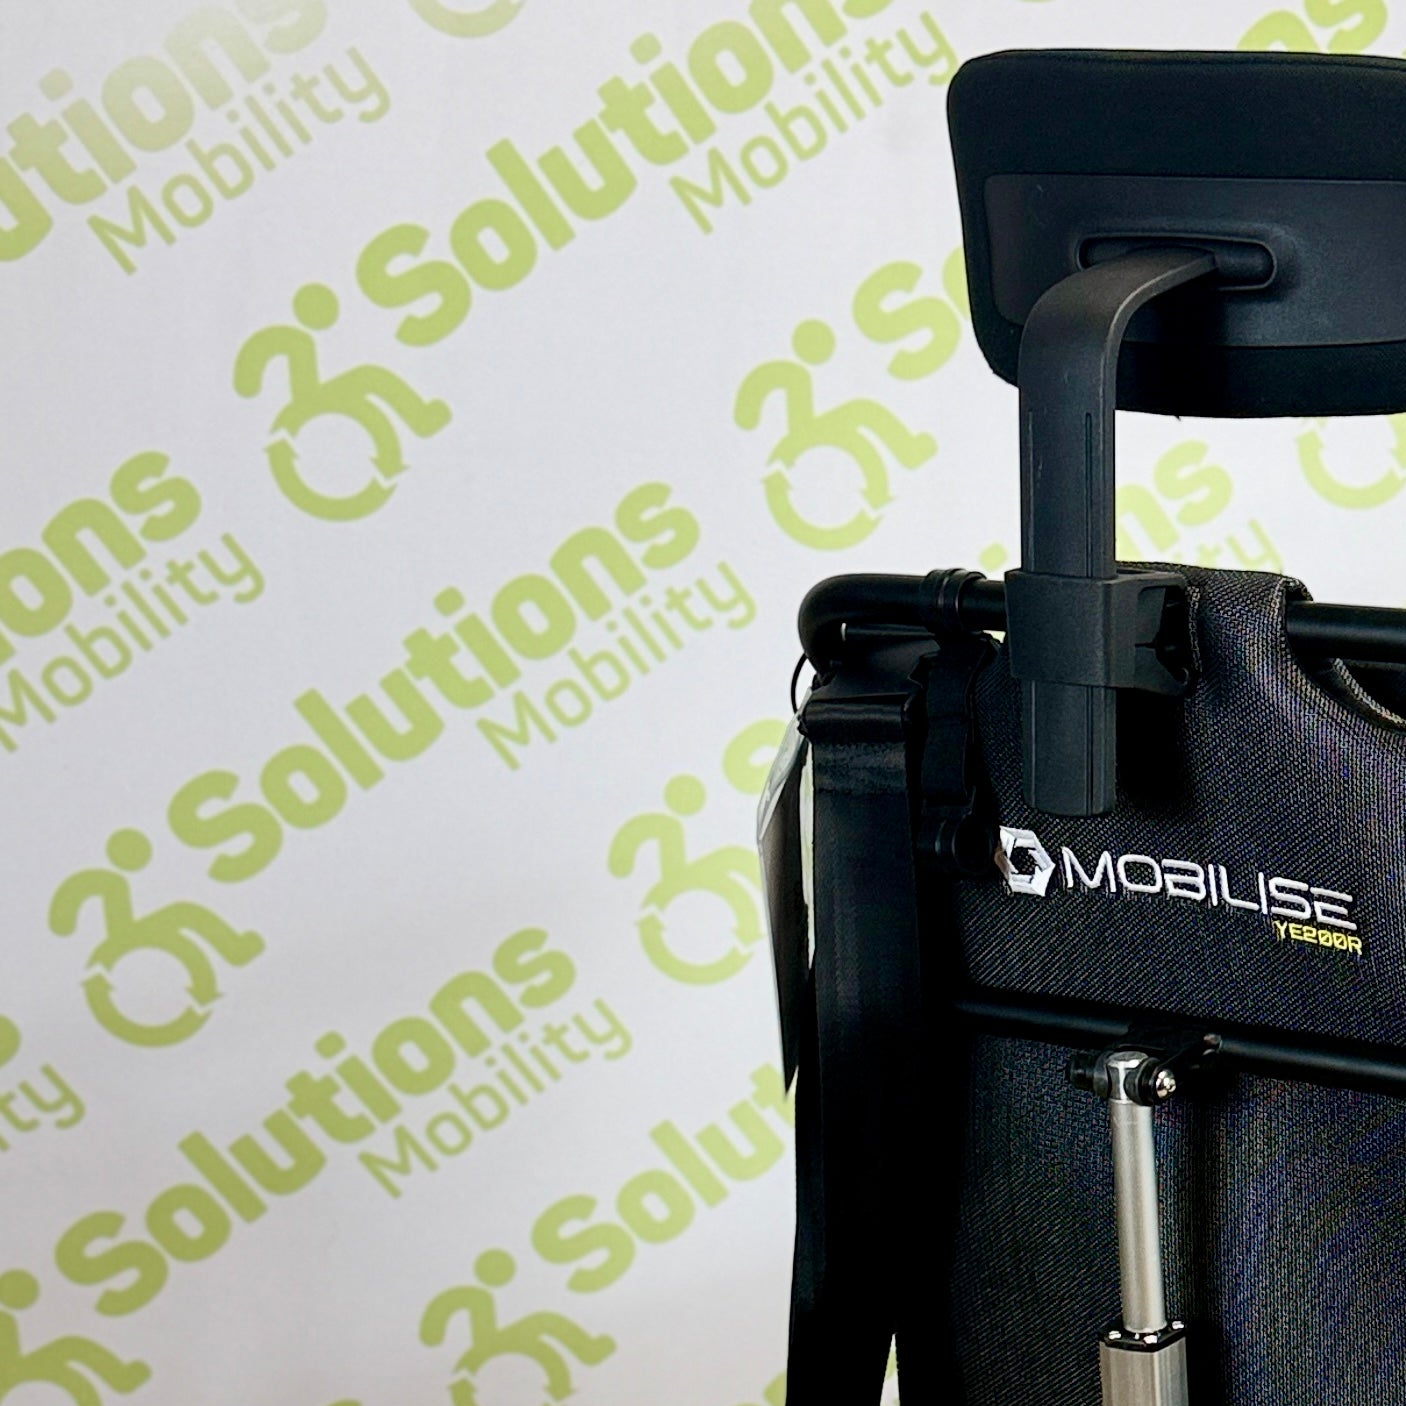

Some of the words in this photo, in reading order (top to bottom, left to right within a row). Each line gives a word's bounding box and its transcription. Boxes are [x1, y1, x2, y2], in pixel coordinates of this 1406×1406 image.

[86, 46, 391, 276] Mobility
[668, 11, 960, 235] Mobility
[168, 482, 701, 883] Solutions
[477, 562, 757, 770] Mobility
[1061, 846, 1358, 931] MOBILISE
[1274, 920, 1364, 955] YE200R
[55, 928, 577, 1317] Solutions
[359, 999, 633, 1198] Mobility
